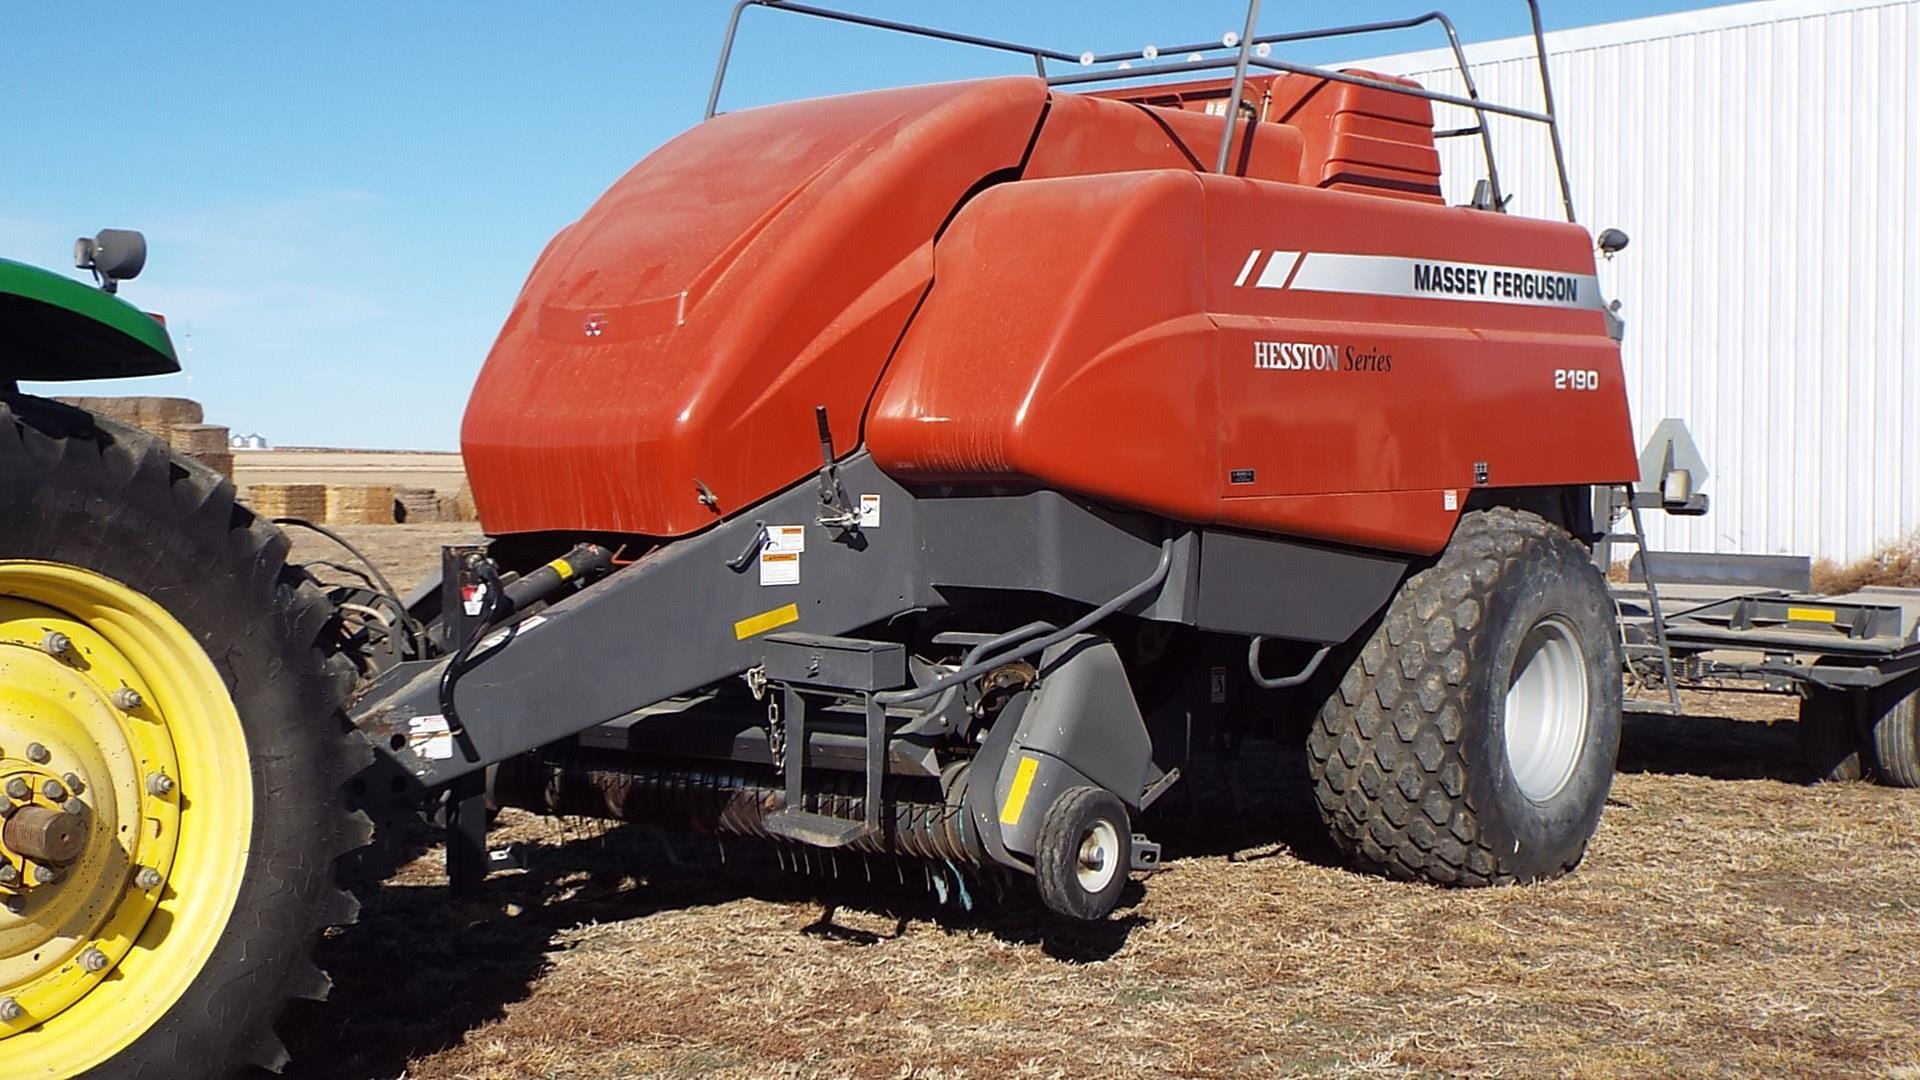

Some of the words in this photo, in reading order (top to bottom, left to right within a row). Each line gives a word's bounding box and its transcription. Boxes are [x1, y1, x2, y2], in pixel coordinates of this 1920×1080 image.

[1414, 264, 1487, 295] MASSEY
[1493, 271, 1577, 302] FERGUSON
[1254, 341, 1339, 371] HESSTON
[1344, 346, 1392, 372] Series
[1555, 369, 1599, 390] 2190
